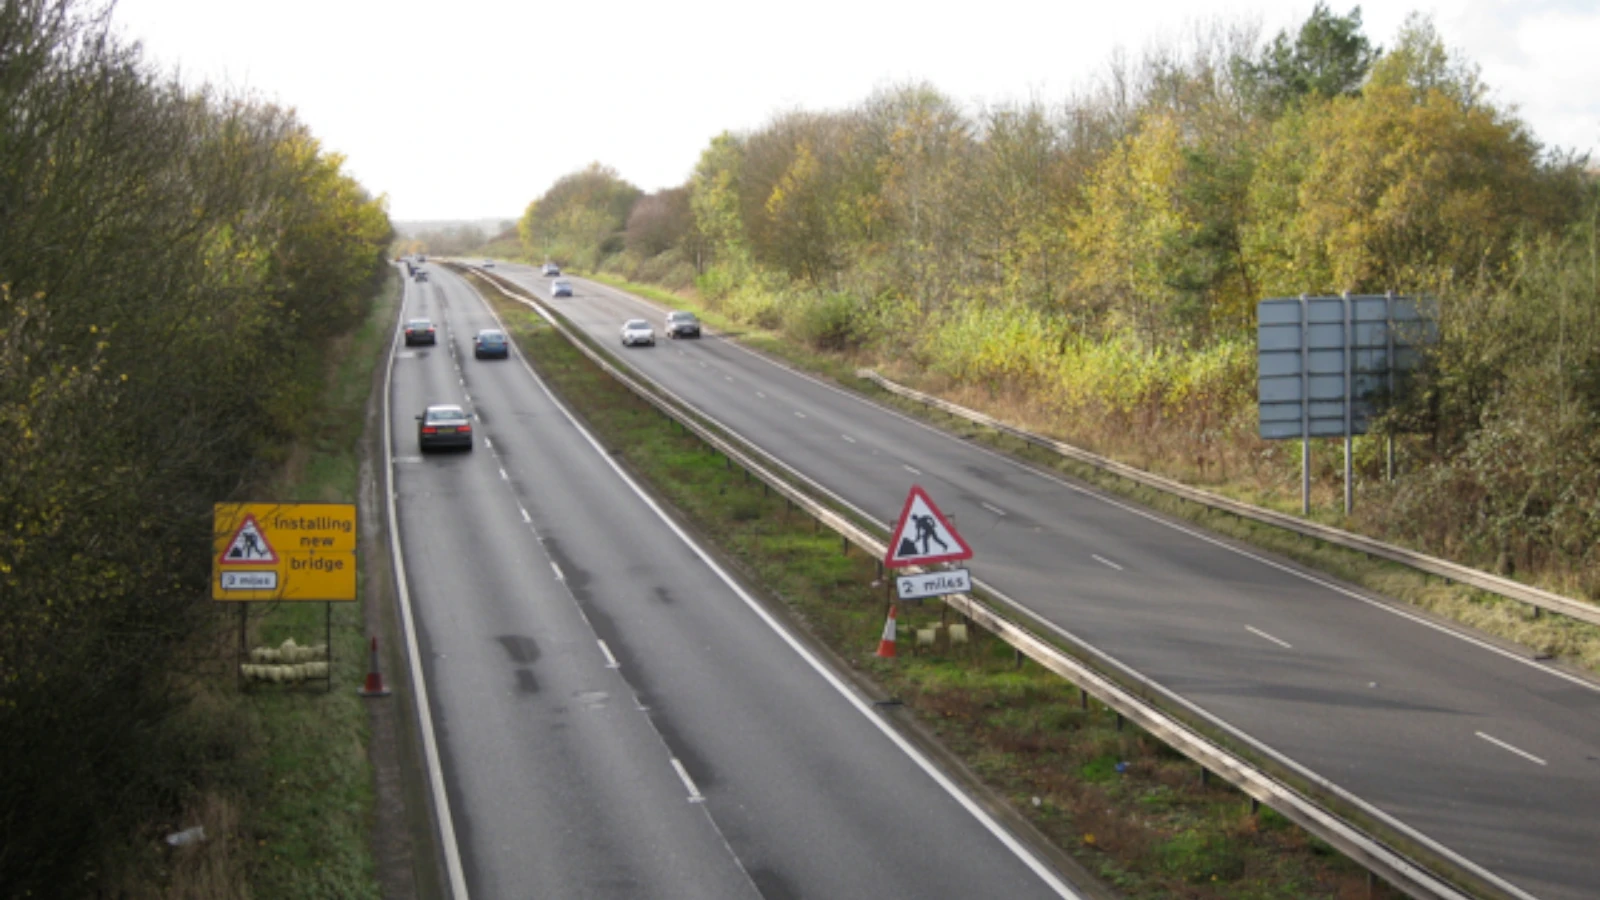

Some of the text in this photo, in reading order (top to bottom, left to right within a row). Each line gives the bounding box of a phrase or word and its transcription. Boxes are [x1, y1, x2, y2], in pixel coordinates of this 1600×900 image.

[299, 536, 335, 547] new
[291, 557, 344, 572] bridge
[228, 575, 235, 585] 2
[902, 576, 964, 593] 2 miles
